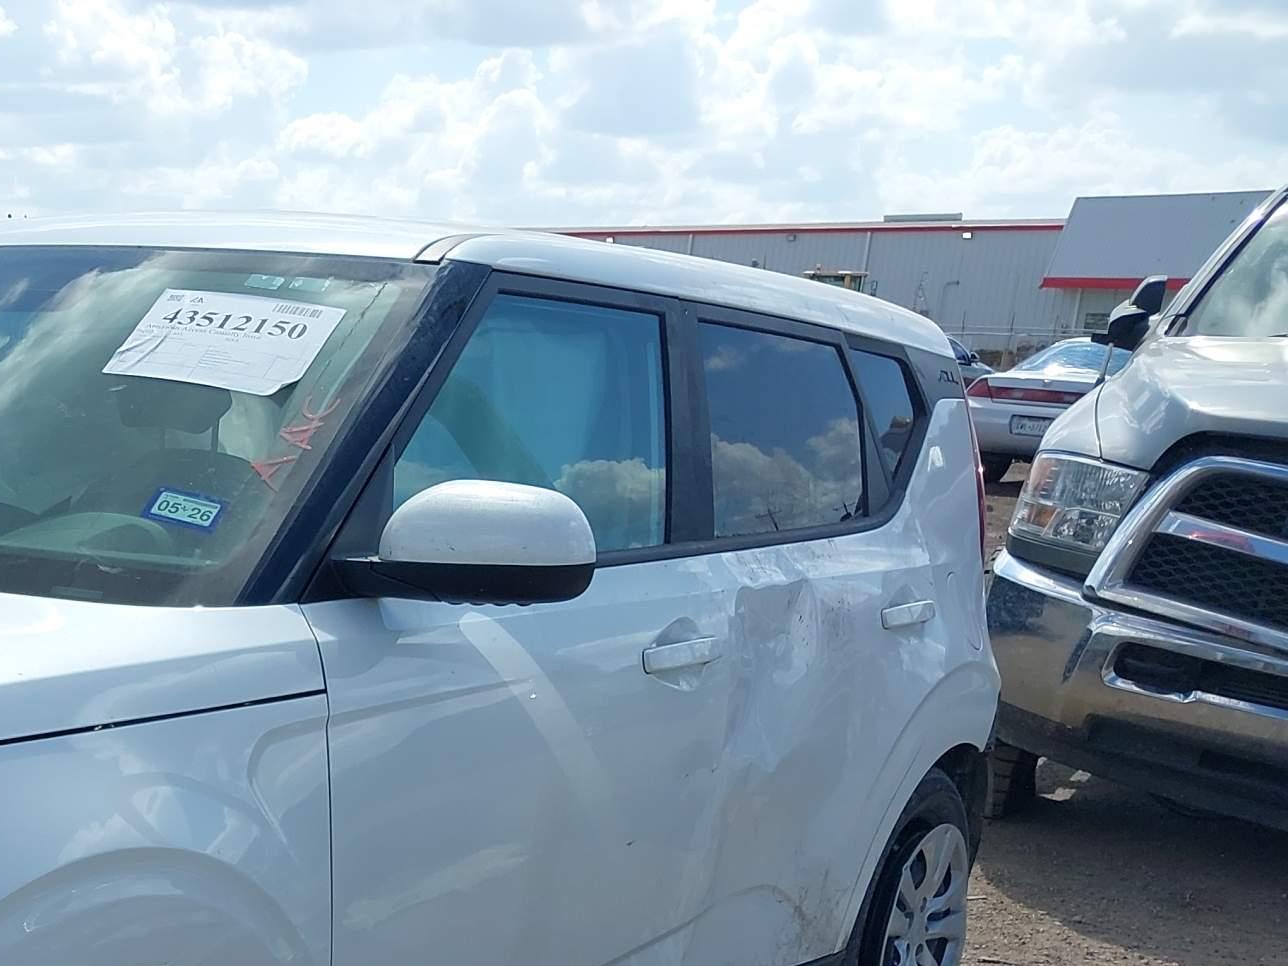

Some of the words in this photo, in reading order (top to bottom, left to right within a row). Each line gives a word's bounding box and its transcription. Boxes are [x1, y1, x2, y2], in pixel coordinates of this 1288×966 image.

[162, 307, 308, 340] 43512150
[157, 499, 183, 514] 05
[187, 507, 213, 522] 26
